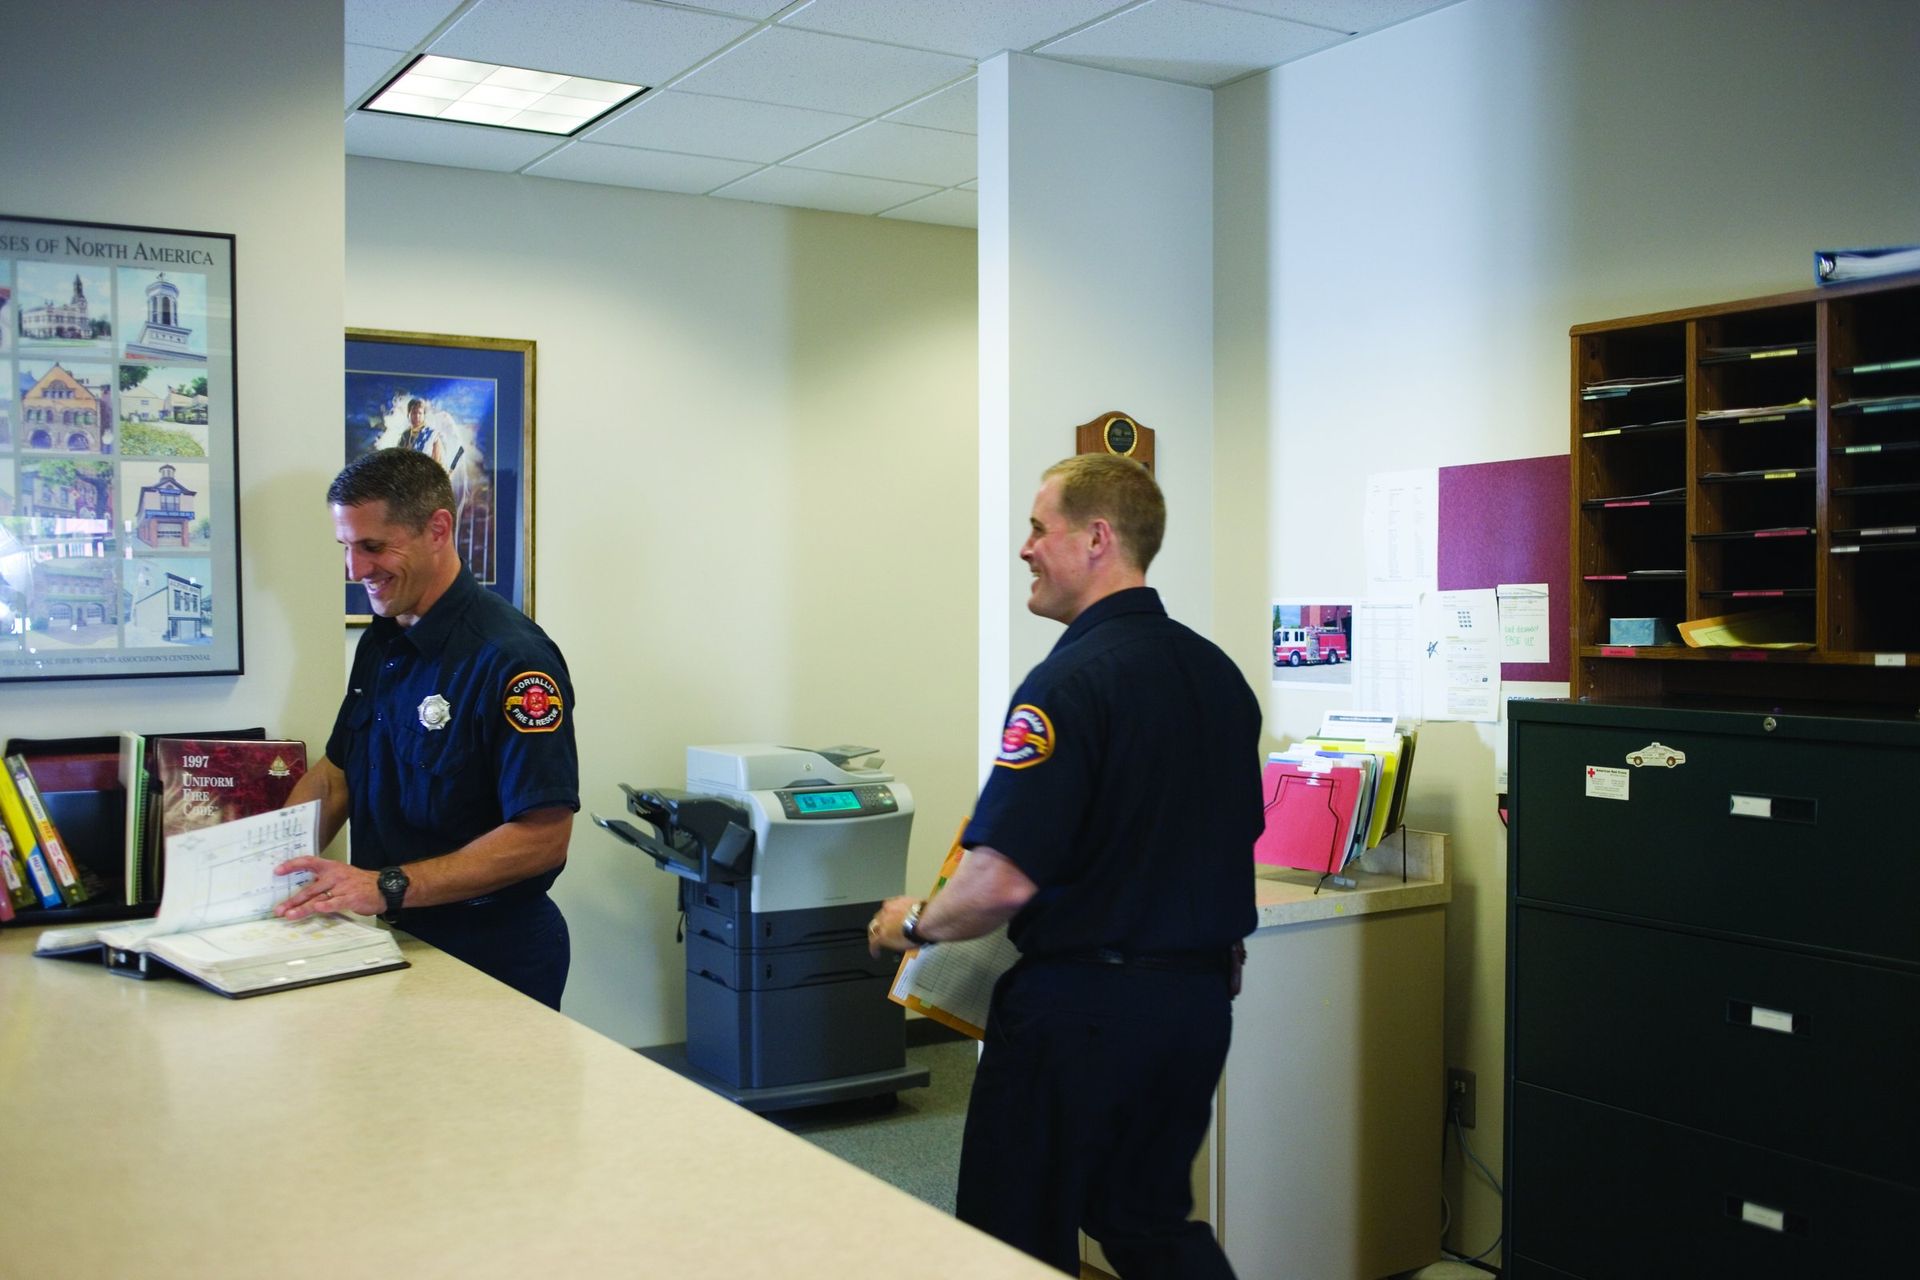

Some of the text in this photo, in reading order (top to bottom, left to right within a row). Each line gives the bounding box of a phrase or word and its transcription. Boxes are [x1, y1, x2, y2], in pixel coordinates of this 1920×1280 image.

[0, 234, 214, 266] SES OF NORTH AMERICA
[513, 677, 555, 693] CORVALLIS
[513, 708, 528, 723] FIRE
[182, 755, 209, 768] 1997
[182, 772, 234, 787] UNIFORM
[182, 788, 209, 801] FIRE
